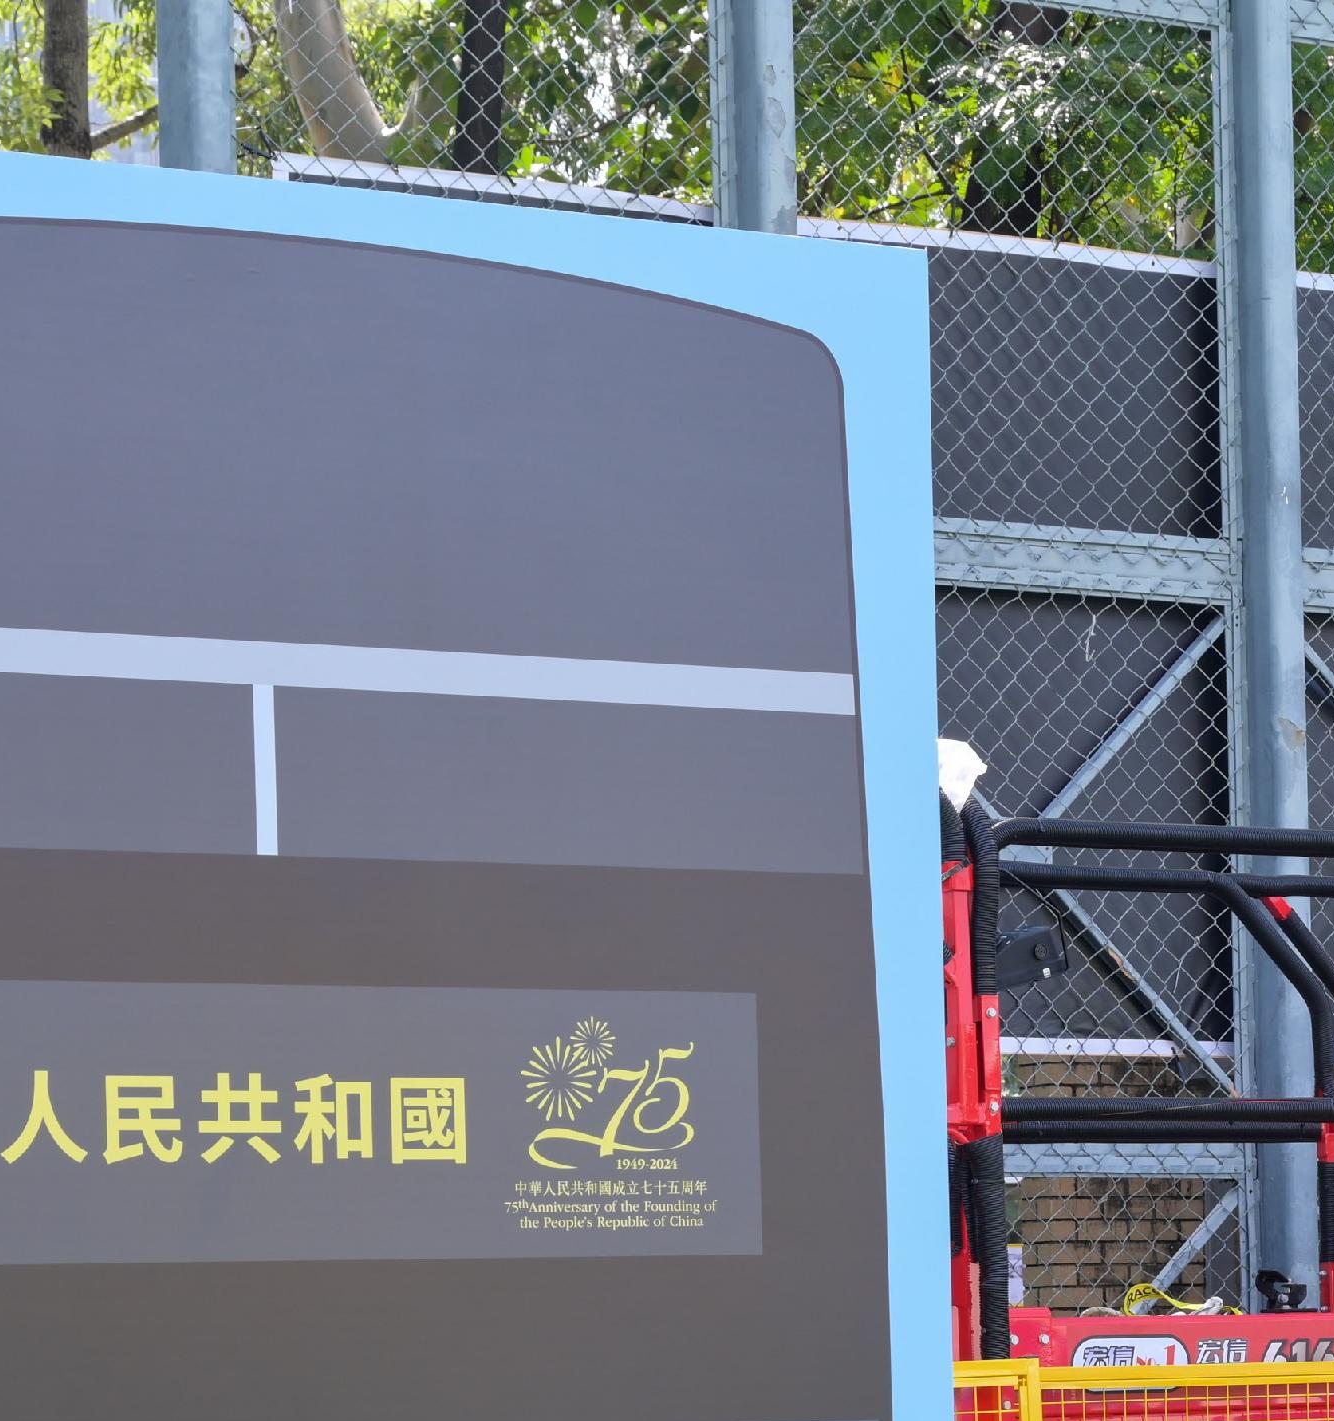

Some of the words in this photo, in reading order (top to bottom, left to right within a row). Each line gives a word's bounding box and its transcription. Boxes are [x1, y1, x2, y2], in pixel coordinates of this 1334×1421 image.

[616, 1158, 679, 1170] 1949-2024
[515, 1180, 708, 1197] 中華人民共和國成立七十五周年
[529, 1201, 601, 1216] Anniversary
[604, 1200, 617, 1213] of
[620, 1200, 640, 1213] the
[644, 1200, 701, 1215] Founding
[704, 1200, 718, 1212] of
[520, 1215, 540, 1229] the
[544, 1215, 593, 1232] People's
[597, 1214, 650, 1231] Republic
[653, 1214, 667, 1228] of
[670, 1214, 704, 1227] China
